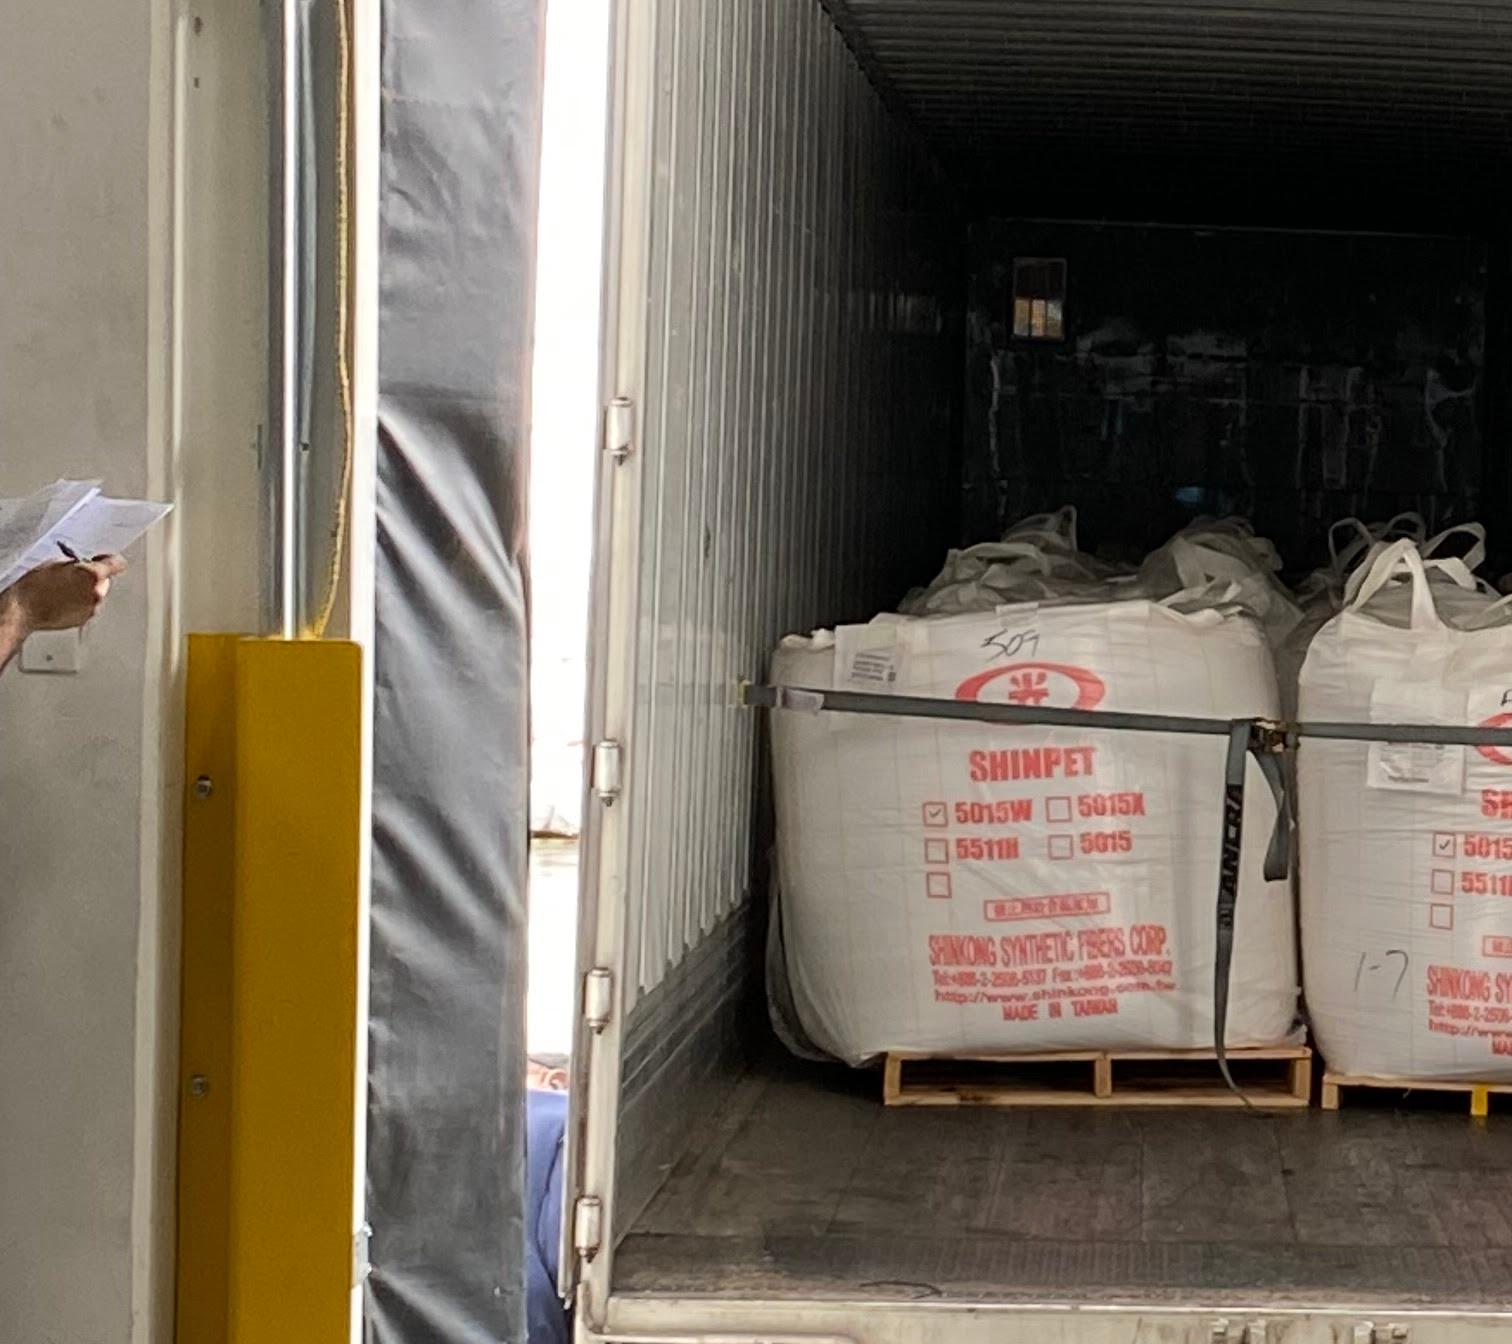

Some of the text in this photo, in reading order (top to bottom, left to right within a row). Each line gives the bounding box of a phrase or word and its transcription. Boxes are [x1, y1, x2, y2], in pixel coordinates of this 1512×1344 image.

[969, 747, 1096, 782] SHINPET
[955, 799, 1032, 824] 5015W
[1080, 830, 1133, 855] 5015
[929, 924, 1171, 968] SHINKONG SYNTHETIC FIBERS CORP.
[1427, 965, 1490, 1002] SHINKONG
[1004, 999, 1118, 1021] MADE IN TAIWAN
